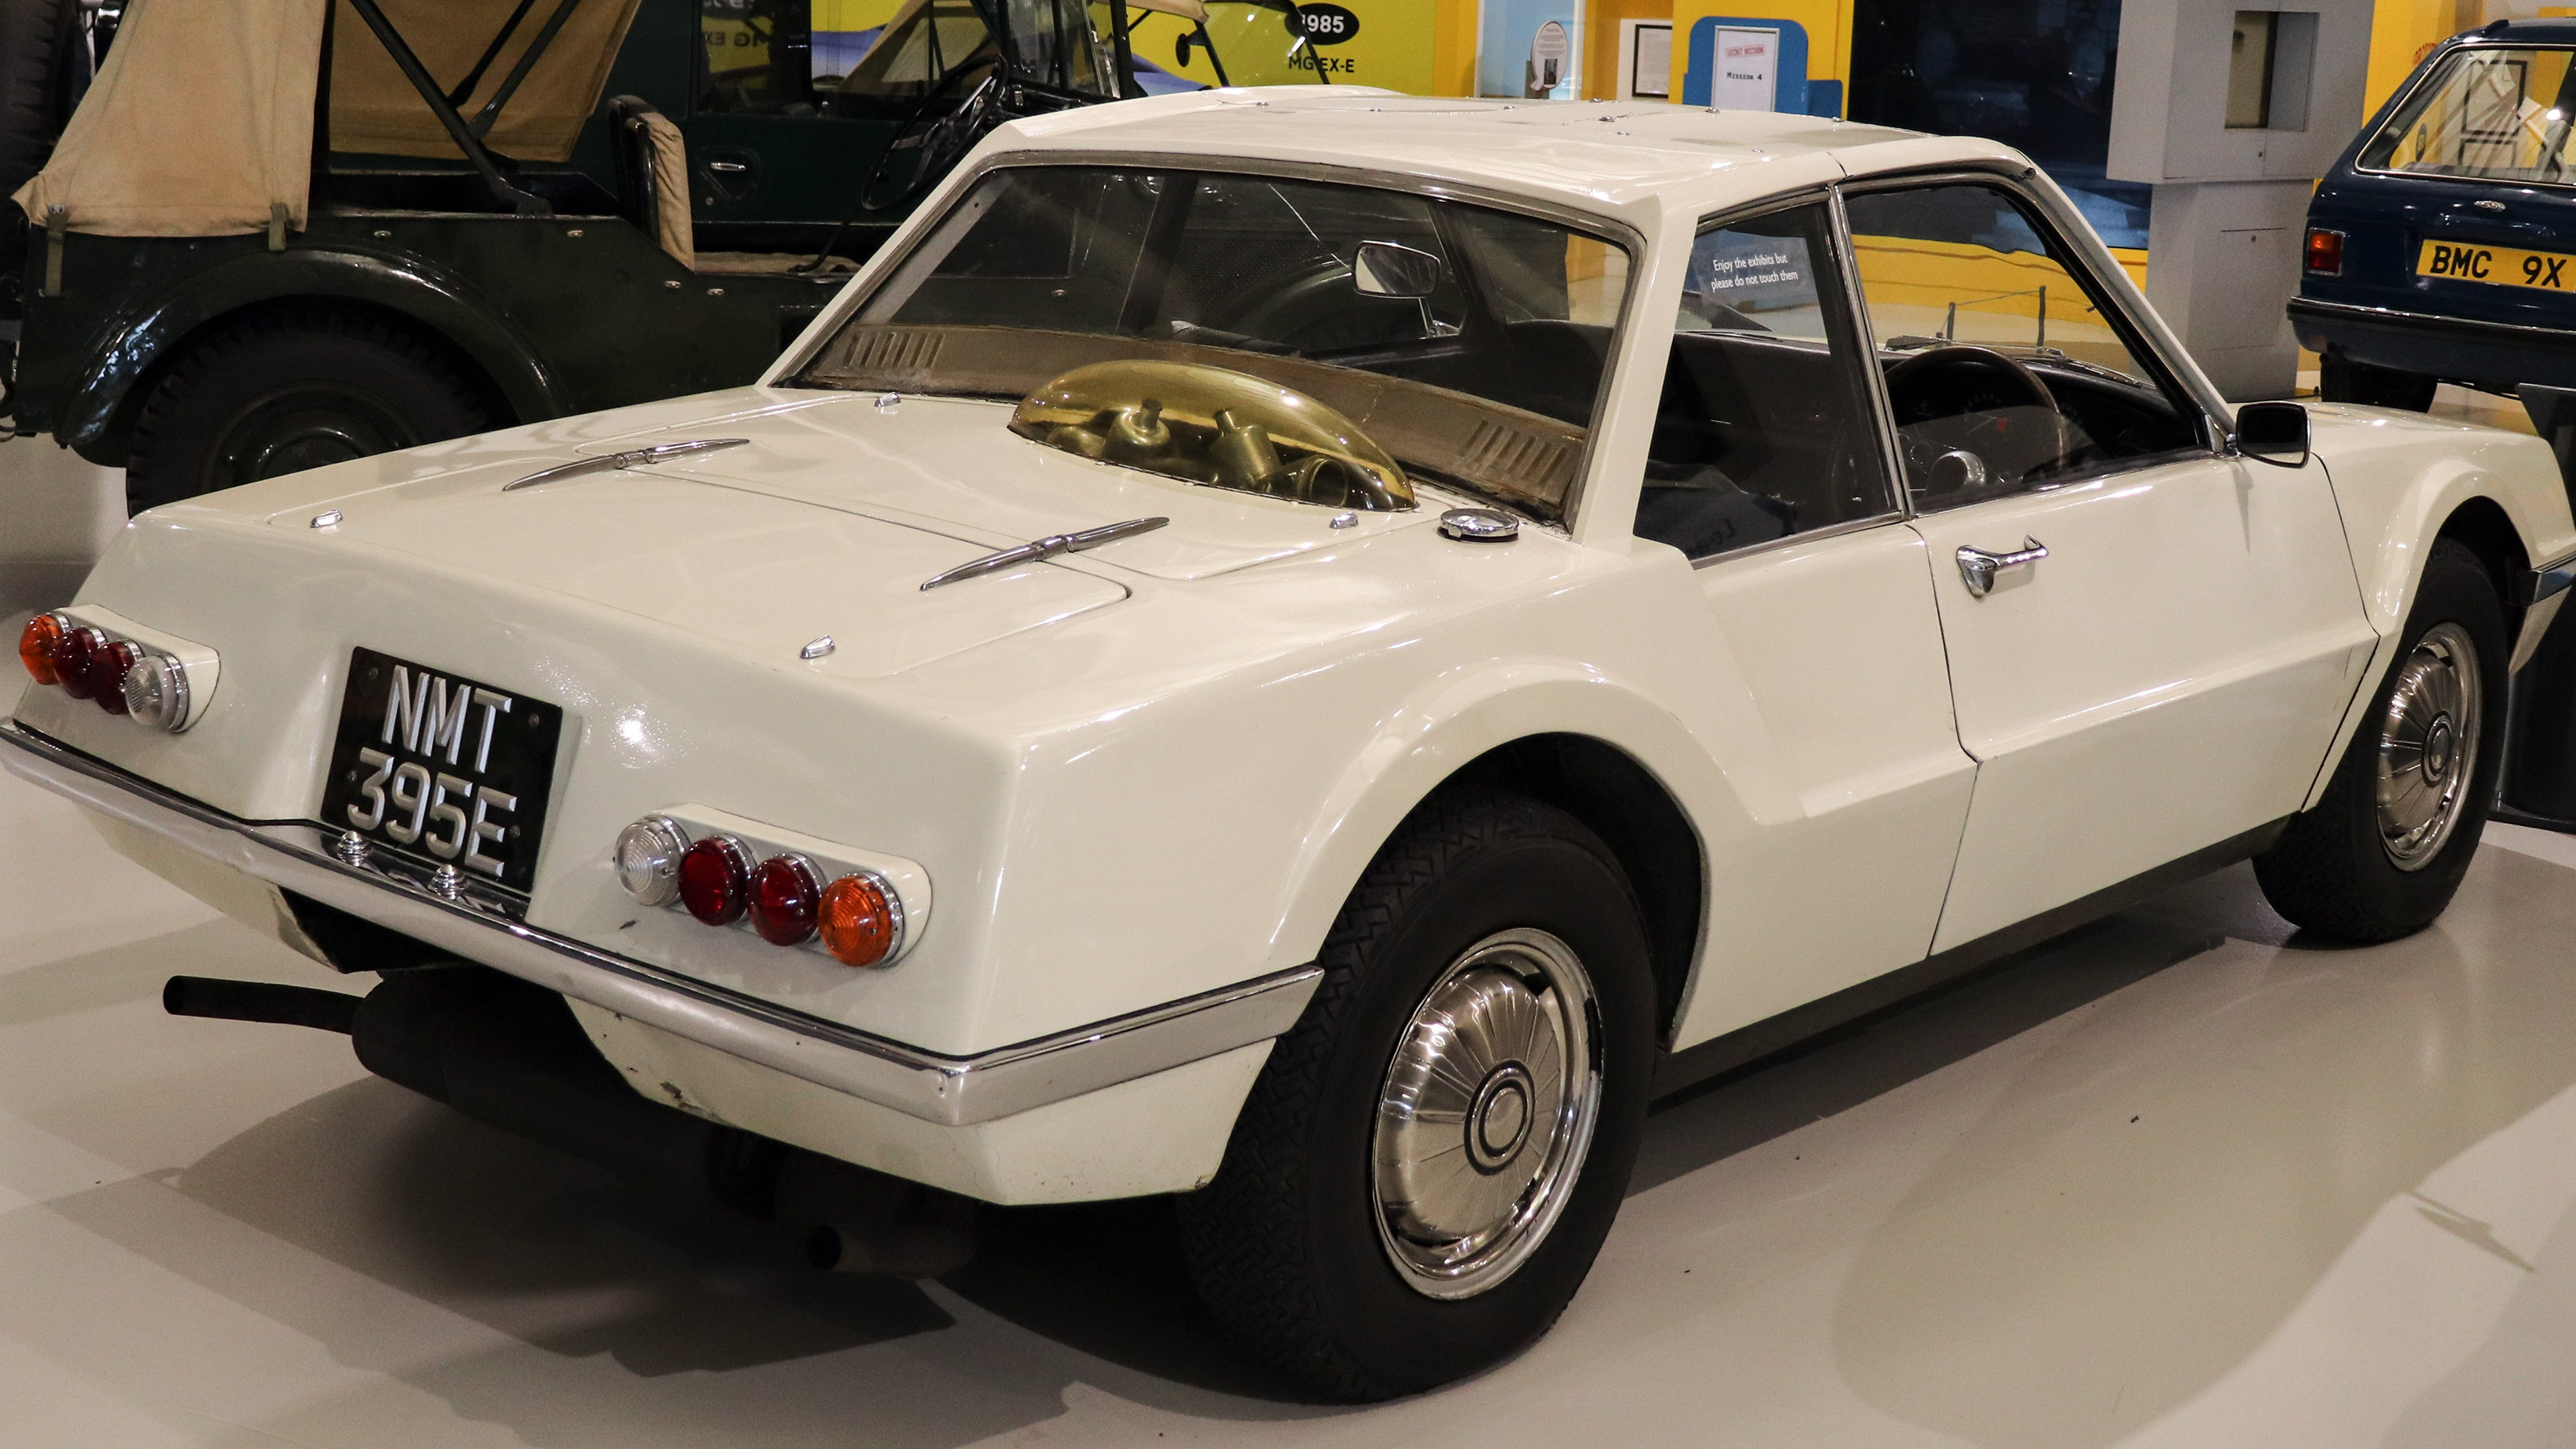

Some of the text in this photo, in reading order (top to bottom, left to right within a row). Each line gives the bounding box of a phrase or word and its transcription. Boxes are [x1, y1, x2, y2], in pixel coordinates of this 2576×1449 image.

[1289, 56, 1354, 73] MG EX-E
[1713, 253, 1789, 273] Enjoy the exhibits but
[2429, 246, 2567, 287] BMC 9X
[1711, 270, 1798, 293] please do not touch them
[381, 664, 513, 774] NMT
[346, 746, 518, 878] 395E
